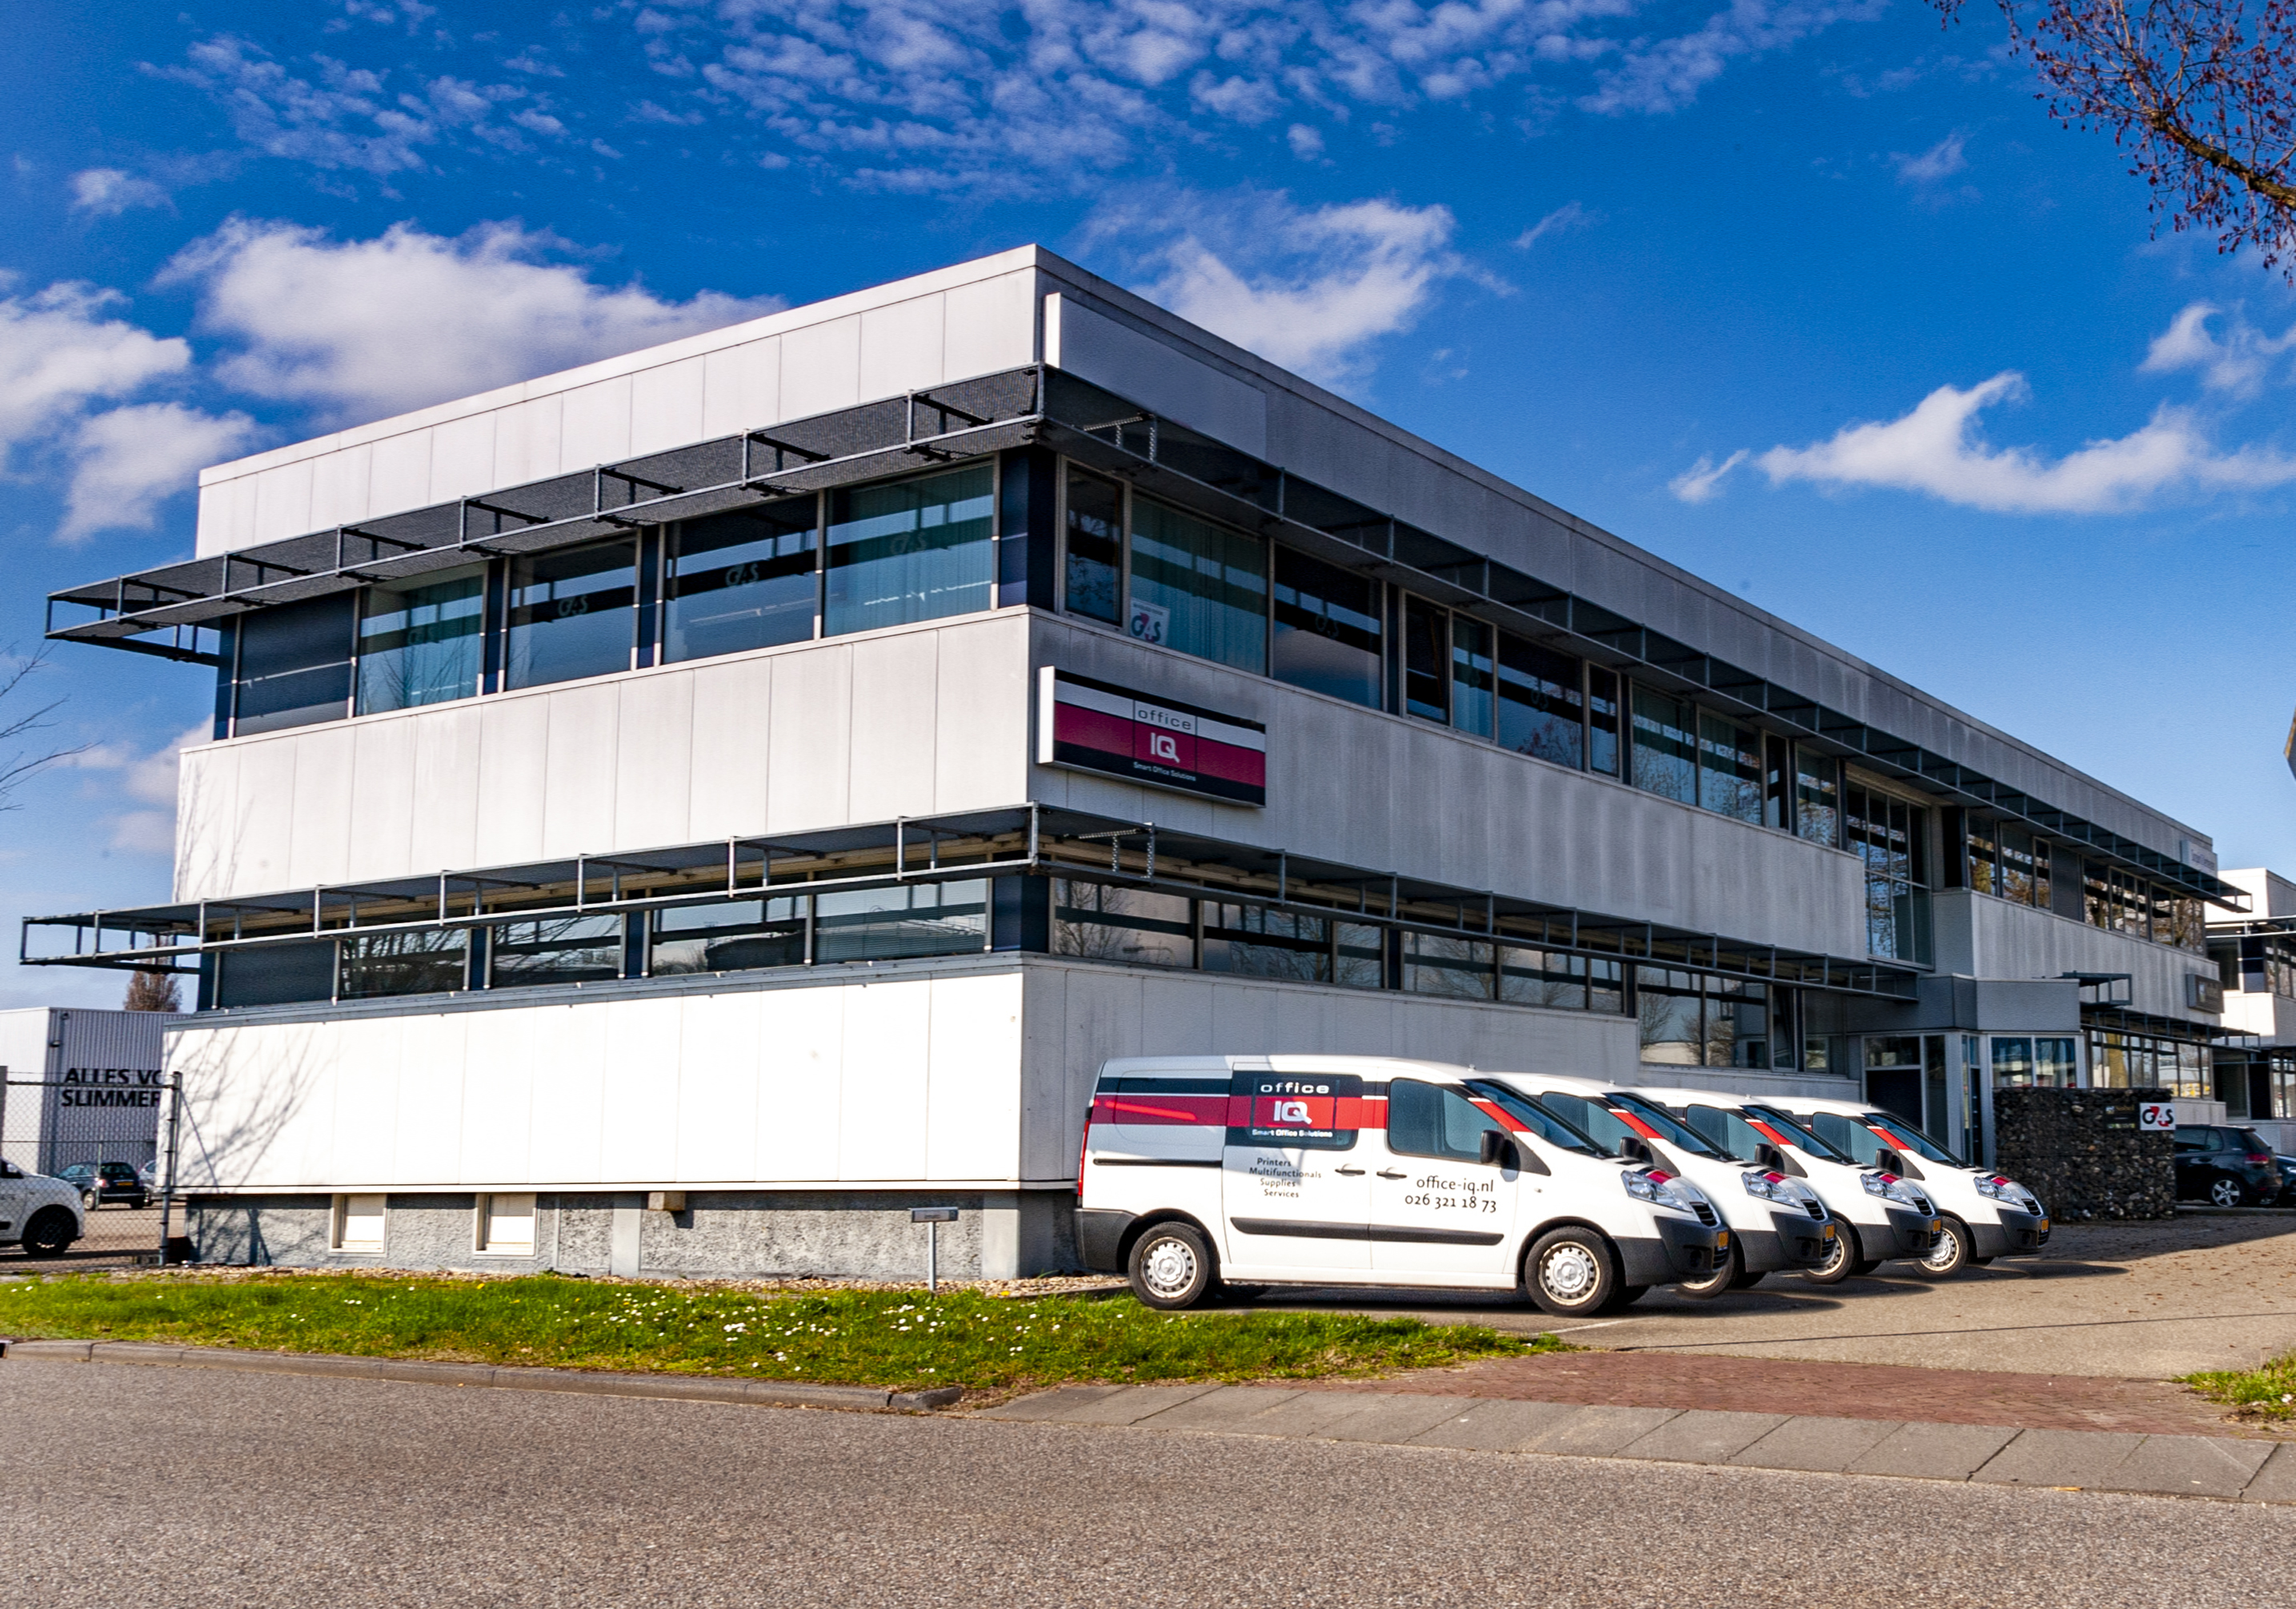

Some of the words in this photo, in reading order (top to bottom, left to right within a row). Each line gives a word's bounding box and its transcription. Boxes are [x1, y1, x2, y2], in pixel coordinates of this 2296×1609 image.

[1132, 612, 1161, 643] G4S
[1138, 710, 1192, 730] office
[1151, 732, 1180, 763] IQ
[1134, 762, 1152, 771] Smart
[1152, 766, 1169, 776] Office
[1170, 770, 1196, 782] Solutions
[64, 1067, 130, 1085] ALLES
[1260, 1082, 1329, 1094] office
[1274, 1101, 1312, 1125] IQ
[2142, 1106, 2174, 1127] G4S
[1276, 1129, 1297, 1137] Office
[1299, 1130, 1333, 1138] Solutions
[1256, 1157, 1291, 1167] Printers
[1248, 1167, 1321, 1179] Multifunctionals
[1260, 1178, 1296, 1188] Supplies
[1264, 1188, 1300, 1198] Services
[1416, 1175, 1494, 1195] office-iq.nl
[1404, 1193, 1430, 1206] 026
[1435, 1197, 1457, 1210] 321
[1462, 1195, 1477, 1209] 18
[1481, 1200, 1497, 1213] 73
